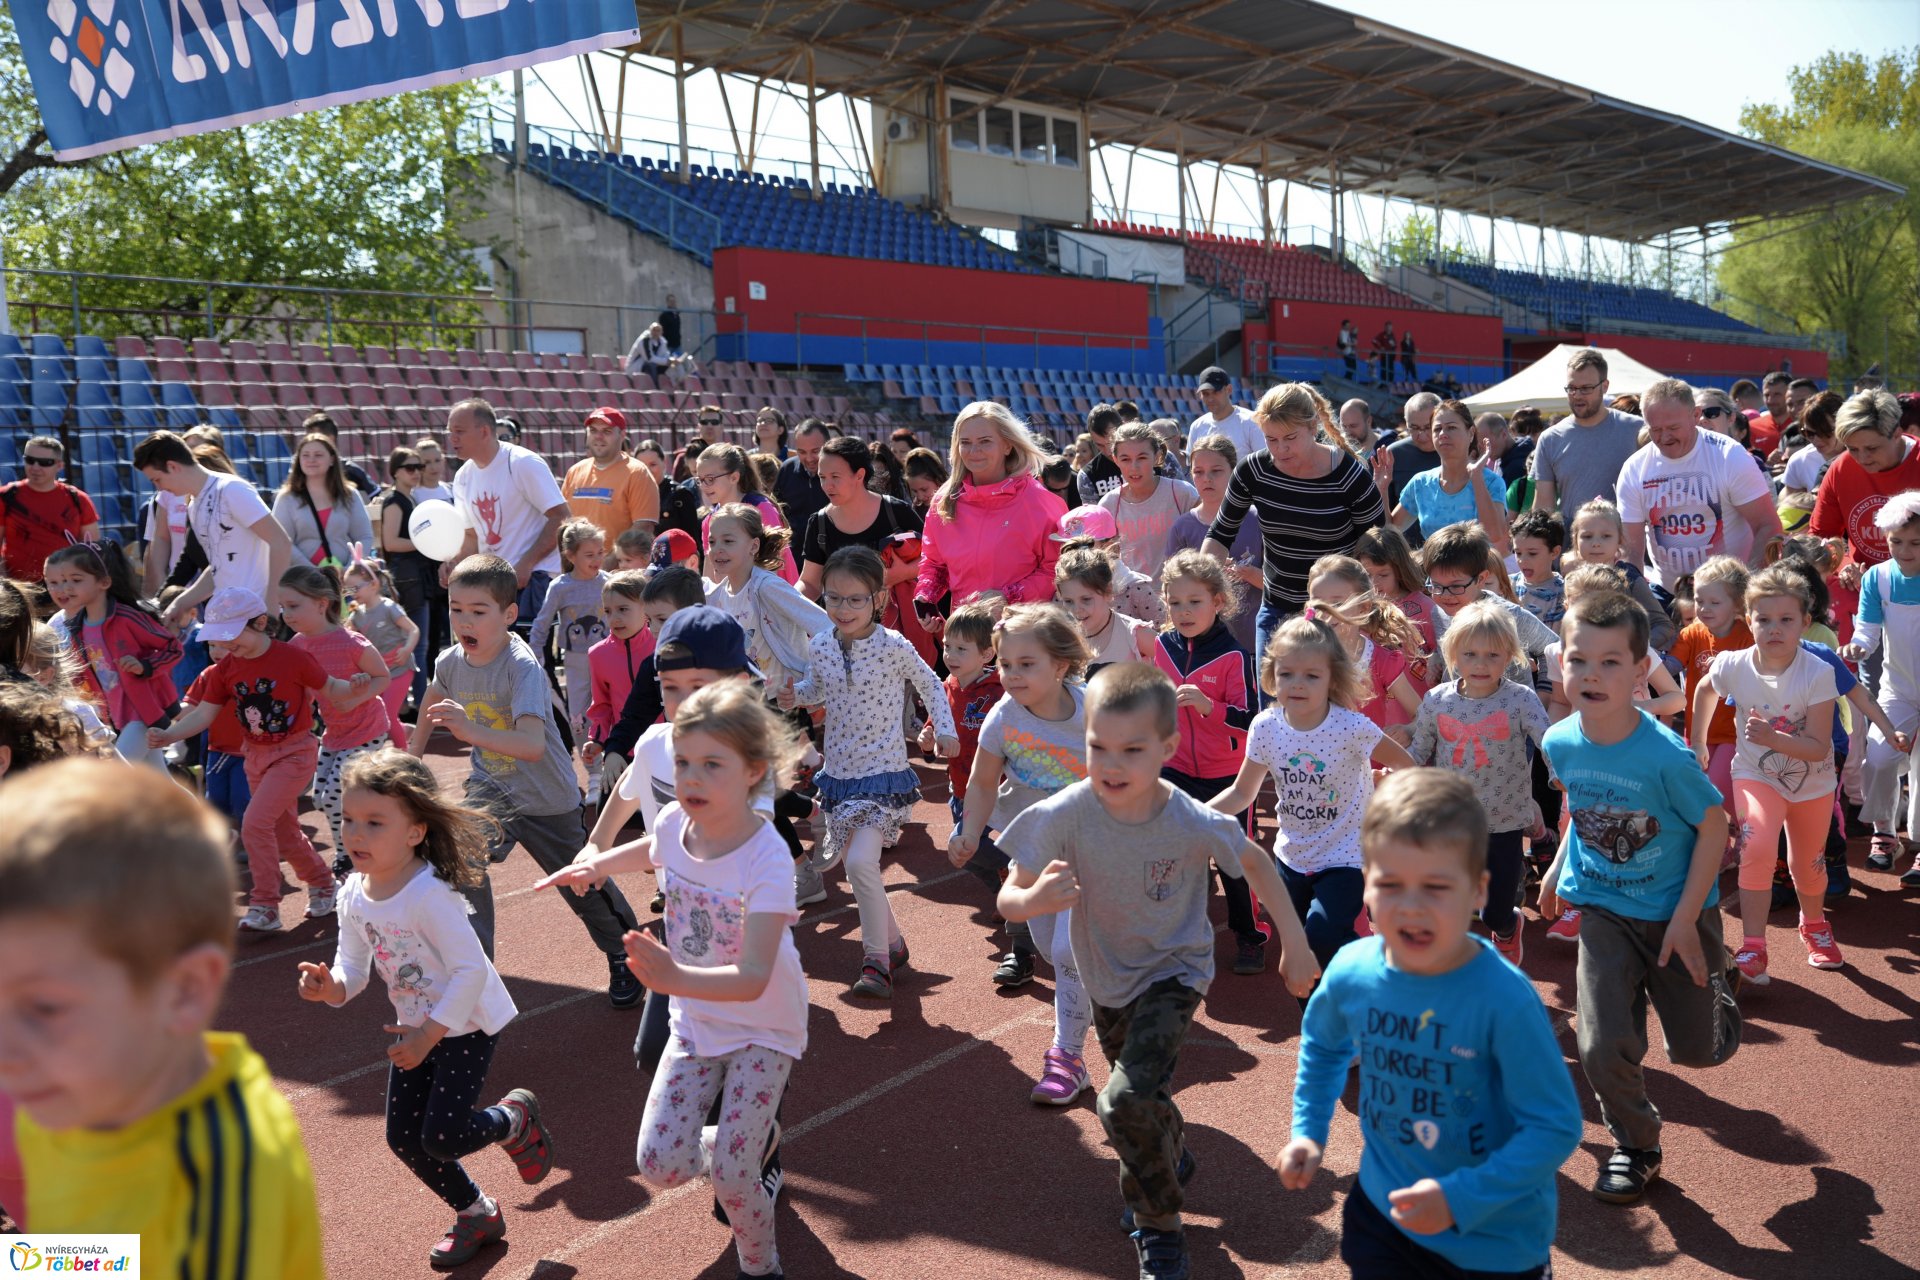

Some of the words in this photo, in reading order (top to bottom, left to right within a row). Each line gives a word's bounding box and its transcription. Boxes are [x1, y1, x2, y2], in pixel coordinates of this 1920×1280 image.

[1659, 513, 1707, 536] 1993
[1279, 766, 1327, 786] TODAY
[1592, 770, 1643, 793] PERFORMANCE
[1287, 789, 1304, 801] AM
[1306, 792, 1314, 803] A
[1367, 1006, 1448, 1051] DON'T
[1360, 1040, 1458, 1086] FORGET
[1366, 1075, 1395, 1105] TO
[1411, 1087, 1447, 1118] BE
